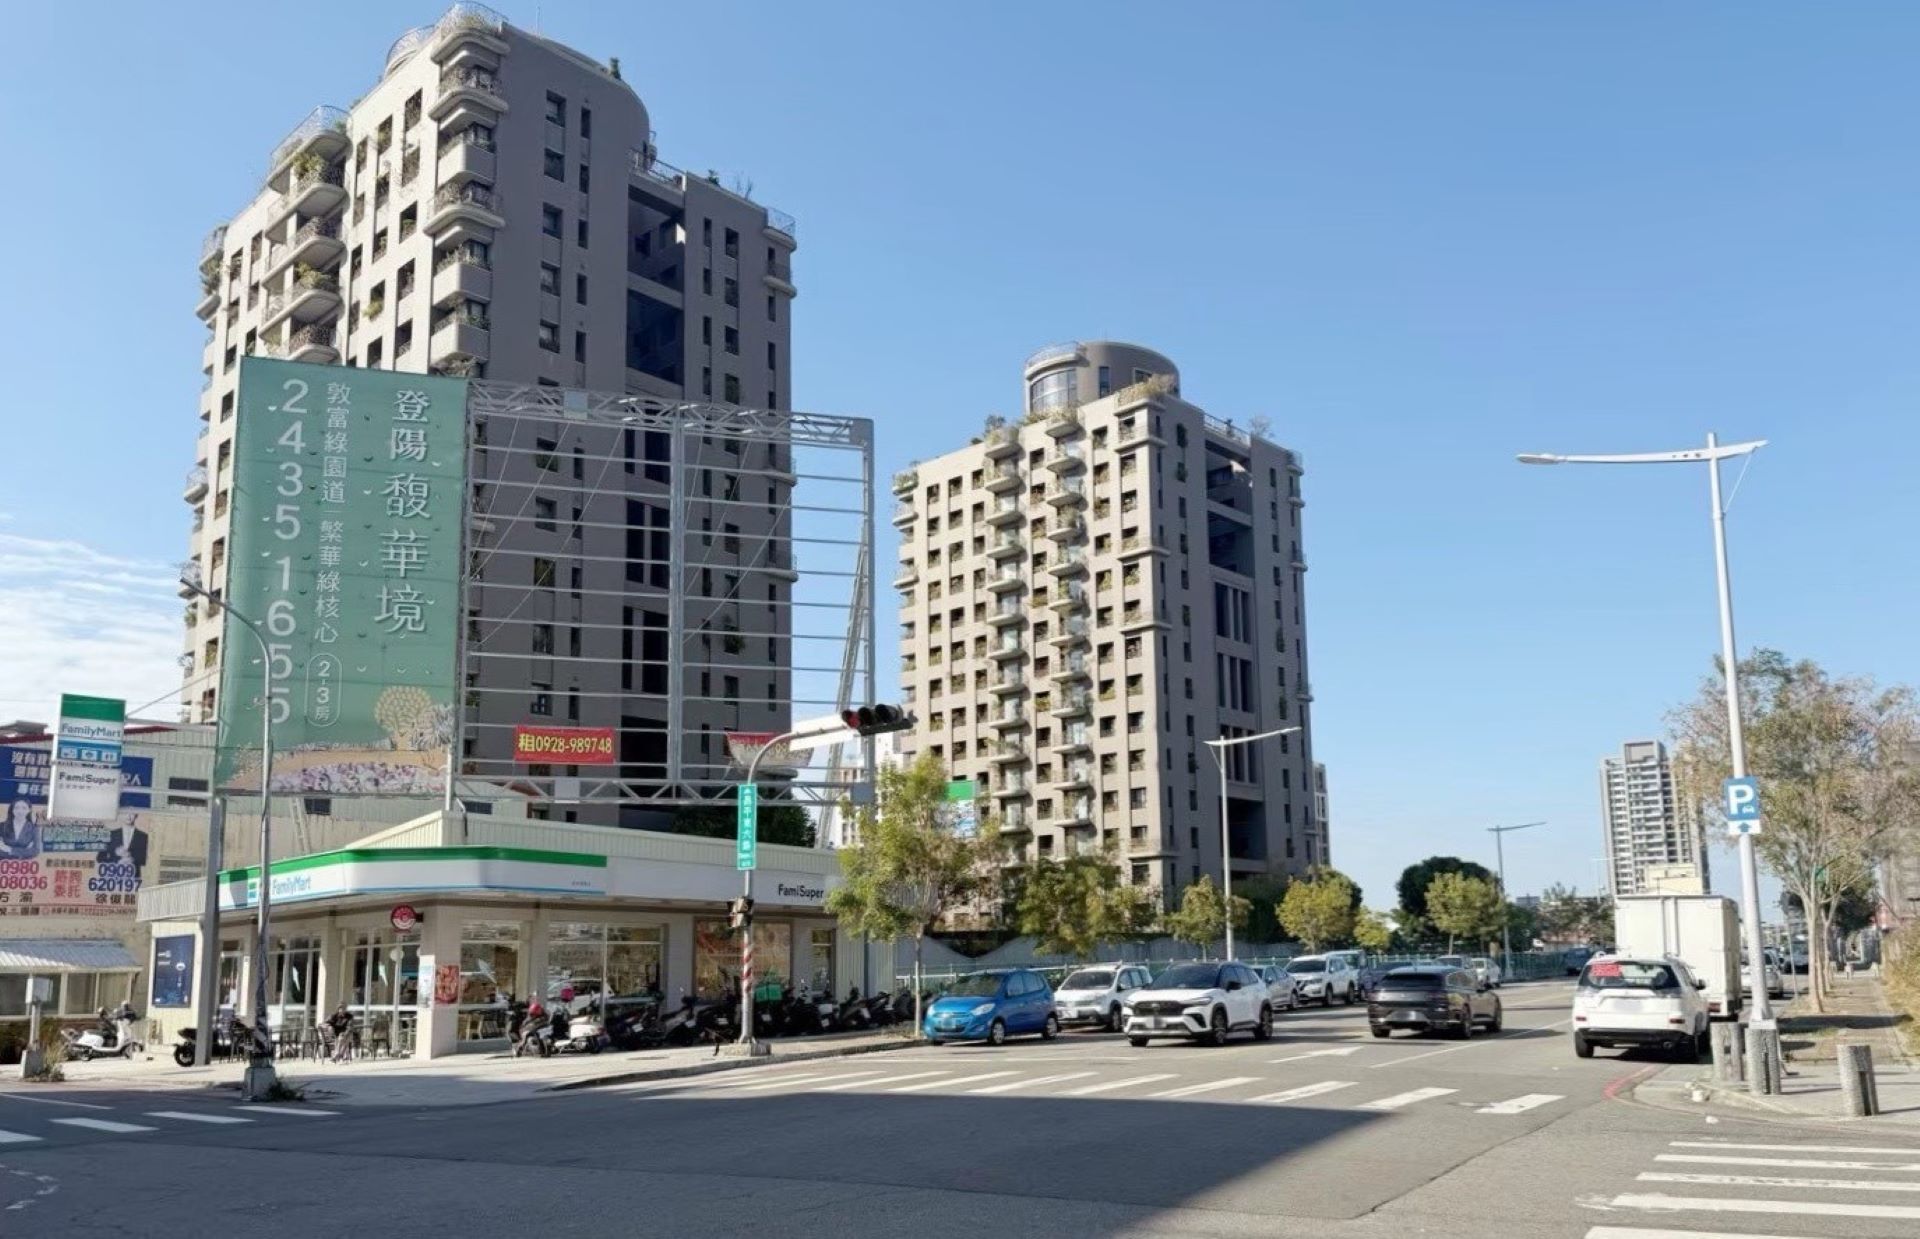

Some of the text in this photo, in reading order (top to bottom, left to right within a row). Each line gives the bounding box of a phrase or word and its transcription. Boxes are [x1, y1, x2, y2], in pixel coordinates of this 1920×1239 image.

[314, 381, 351, 643] 敦富綠園道 繁華綠核心
[61, 722, 121, 738] FamilyMart
[59, 771, 117, 786] FamiSuper
[1728, 784, 1754, 815] P
[0, 860, 39, 875] 0980
[98, 863, 135, 878] 0909
[88, 877, 142, 892] 620197
[272, 875, 312, 896] FamilyMart
[778, 883, 825, 901] FamiSuper
